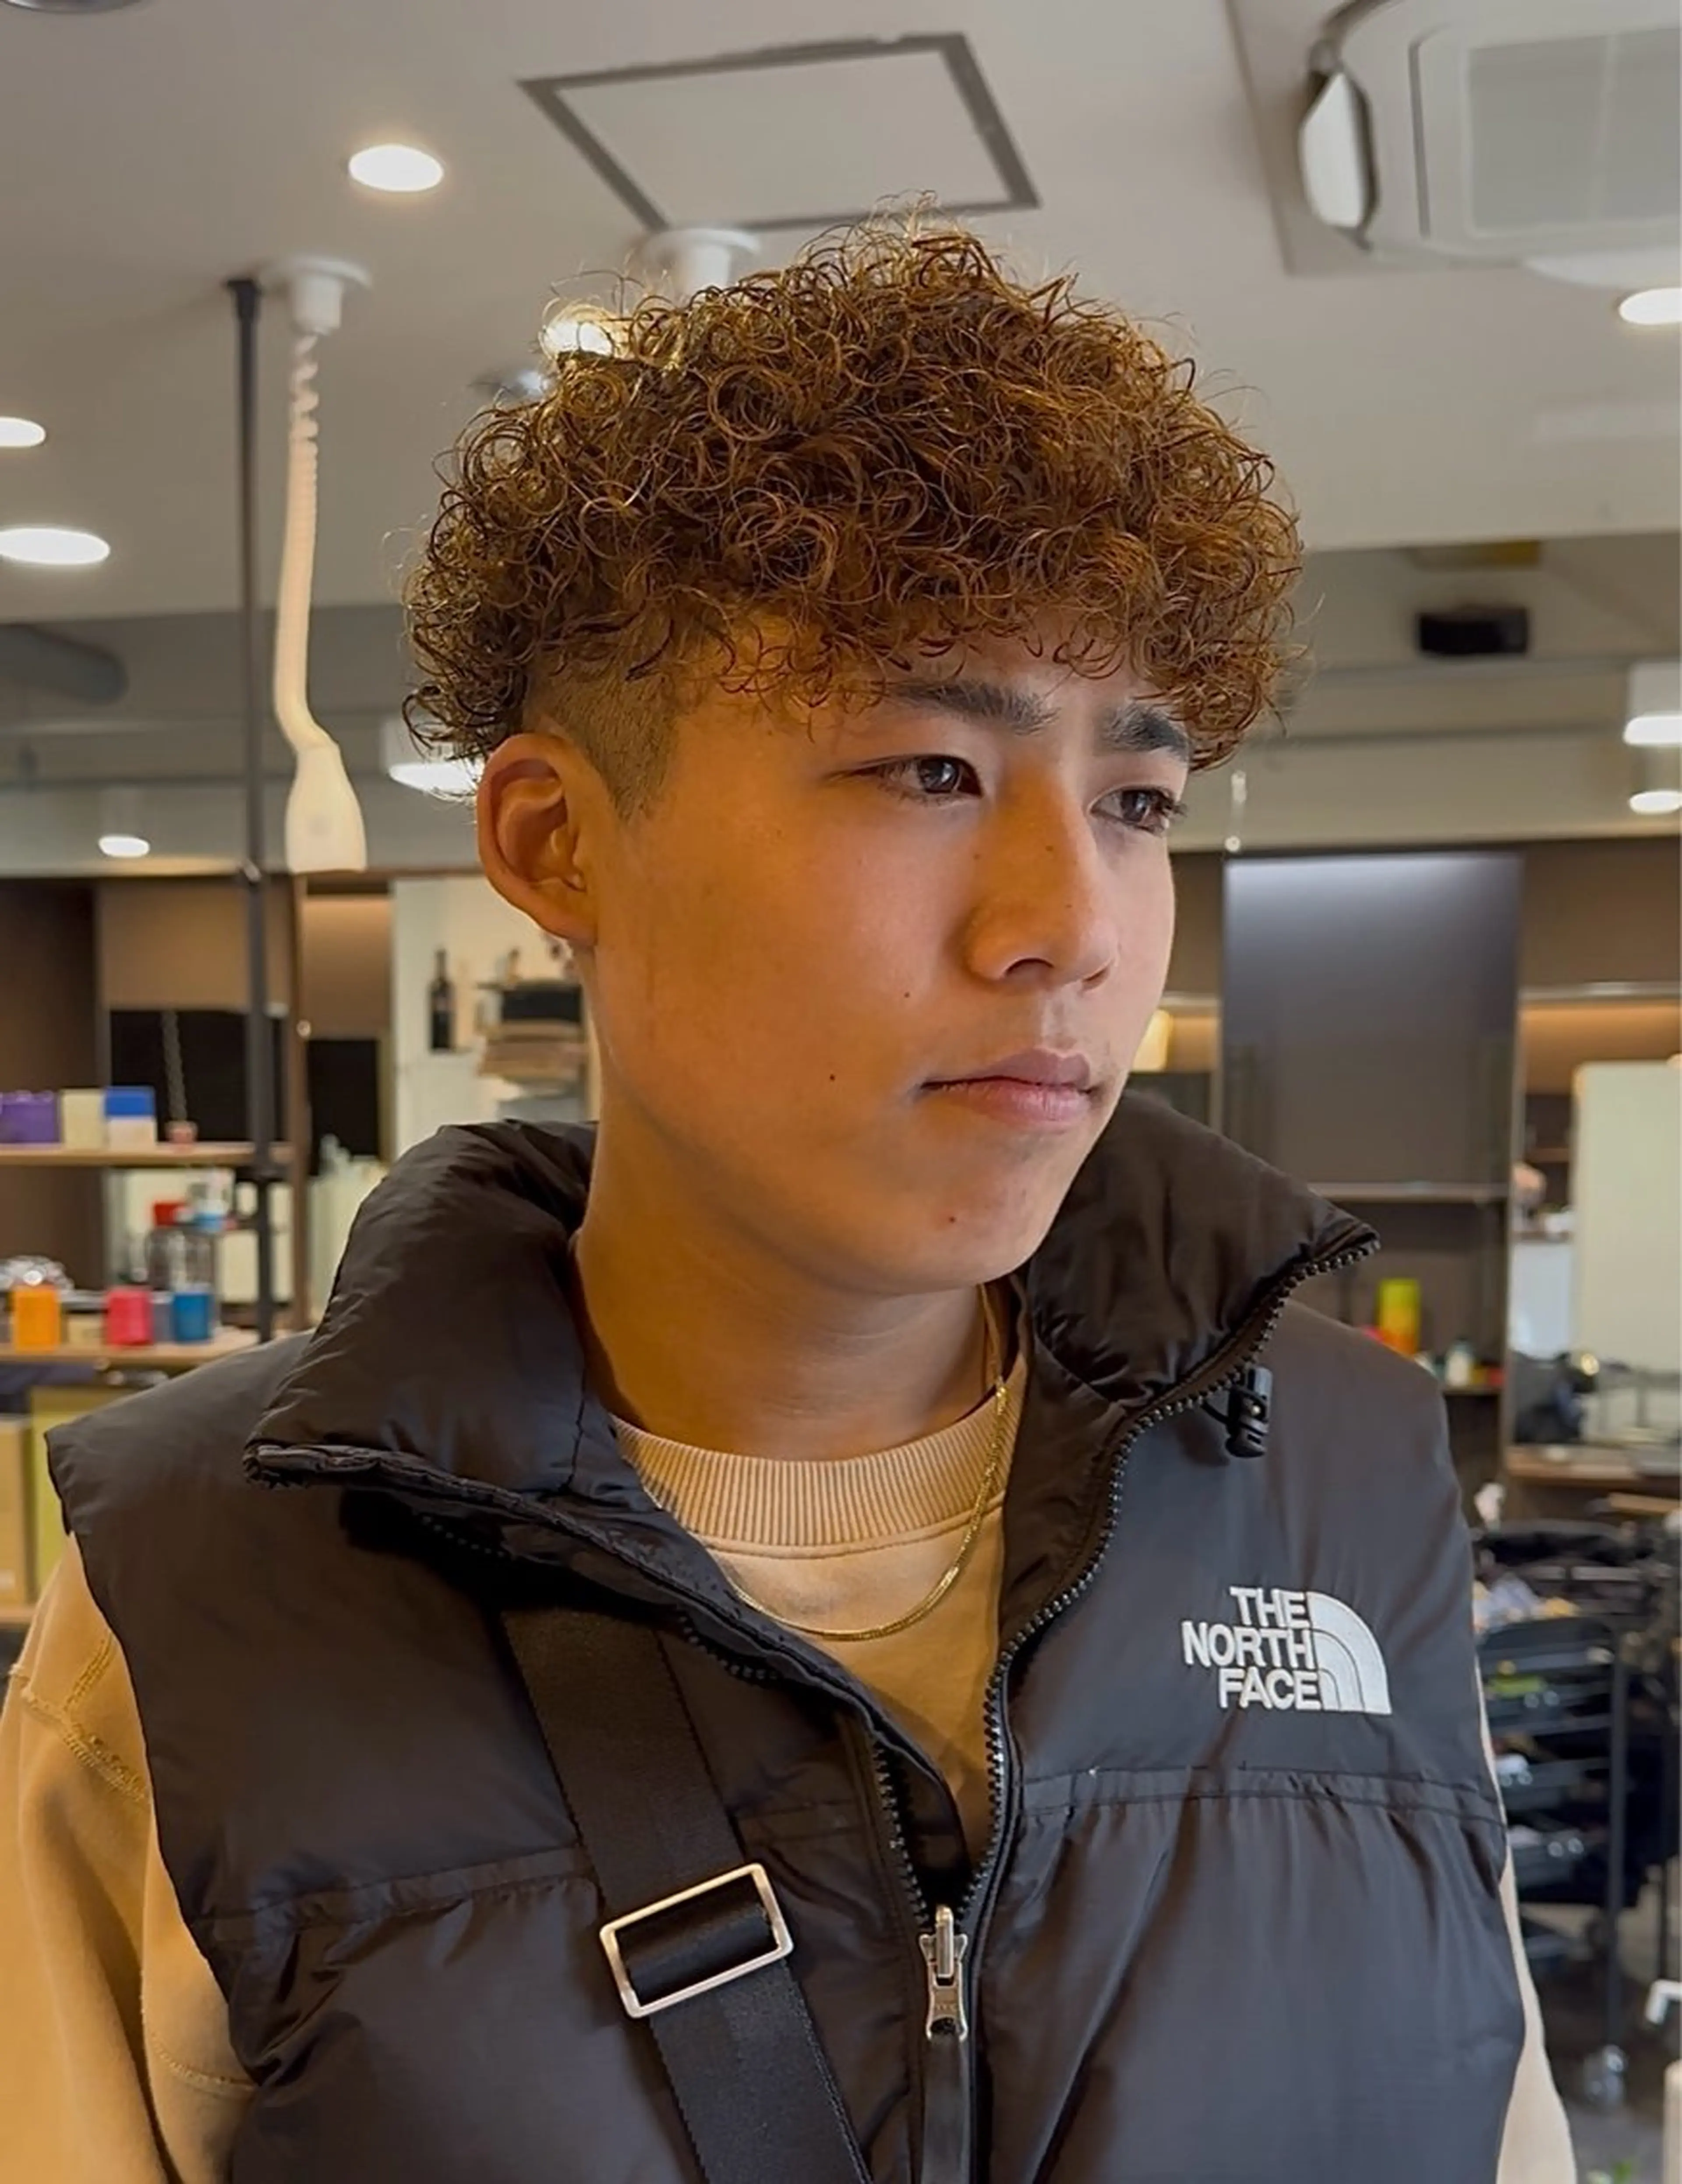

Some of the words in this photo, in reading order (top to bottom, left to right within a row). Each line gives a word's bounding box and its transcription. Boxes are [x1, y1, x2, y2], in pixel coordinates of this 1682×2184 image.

[1230, 1586, 1310, 1628] THE
[1181, 1621, 1315, 1669] NORTH
[1219, 1666, 1322, 1710] FACE
